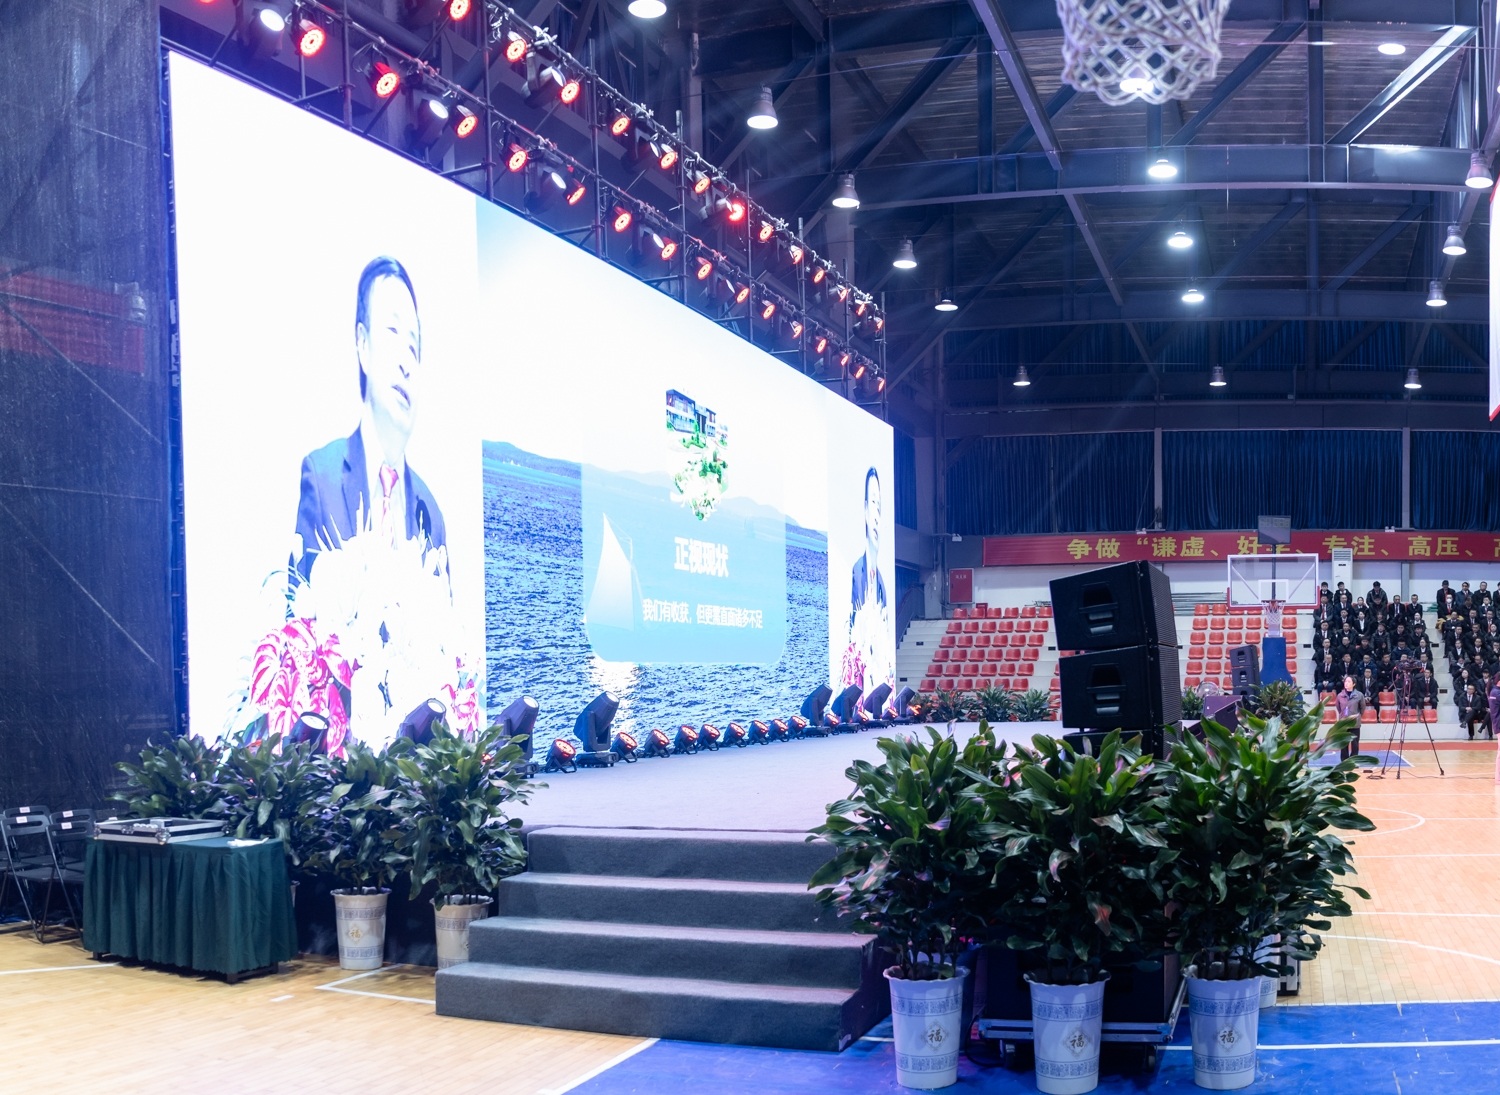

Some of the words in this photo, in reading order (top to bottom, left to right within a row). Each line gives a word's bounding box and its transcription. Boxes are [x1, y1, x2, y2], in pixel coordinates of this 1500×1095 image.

[674, 536, 729, 578] 正视现状
[928, 1029, 943, 1043] 福
[1070, 1034, 1085, 1049] 福
[1220, 1030, 1235, 1044] 福
